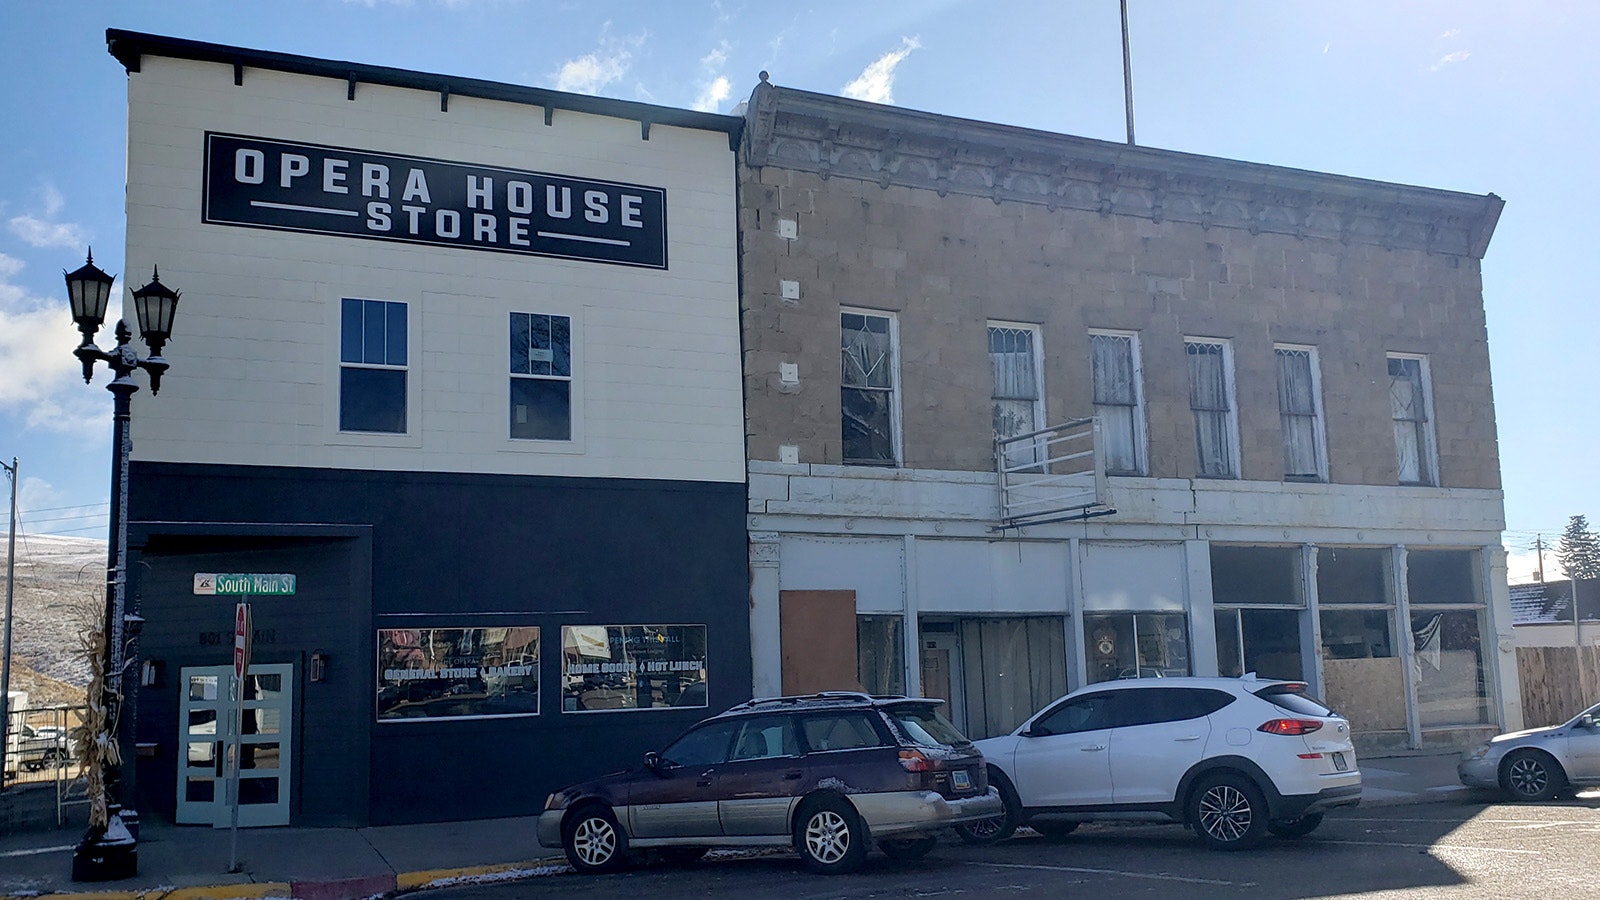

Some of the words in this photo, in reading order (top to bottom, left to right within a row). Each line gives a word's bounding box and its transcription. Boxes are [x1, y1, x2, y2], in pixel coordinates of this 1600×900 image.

[235, 148, 432, 204] OPERA
[466, 175, 644, 229] HOUSE
[366, 201, 531, 246] STORE
[217, 574, 250, 593] South
[255, 575, 278, 593] Main
[281, 576, 294, 593] St
[384, 668, 438, 680] GENERAL
[439, 667, 477, 679] STORE
[488, 665, 533, 678] BAKERY
[568, 663, 600, 674] HOME
[601, 662, 638, 673] GOODS
[647, 661, 669, 672] HOT
[669, 660, 703, 671] LUNCH
